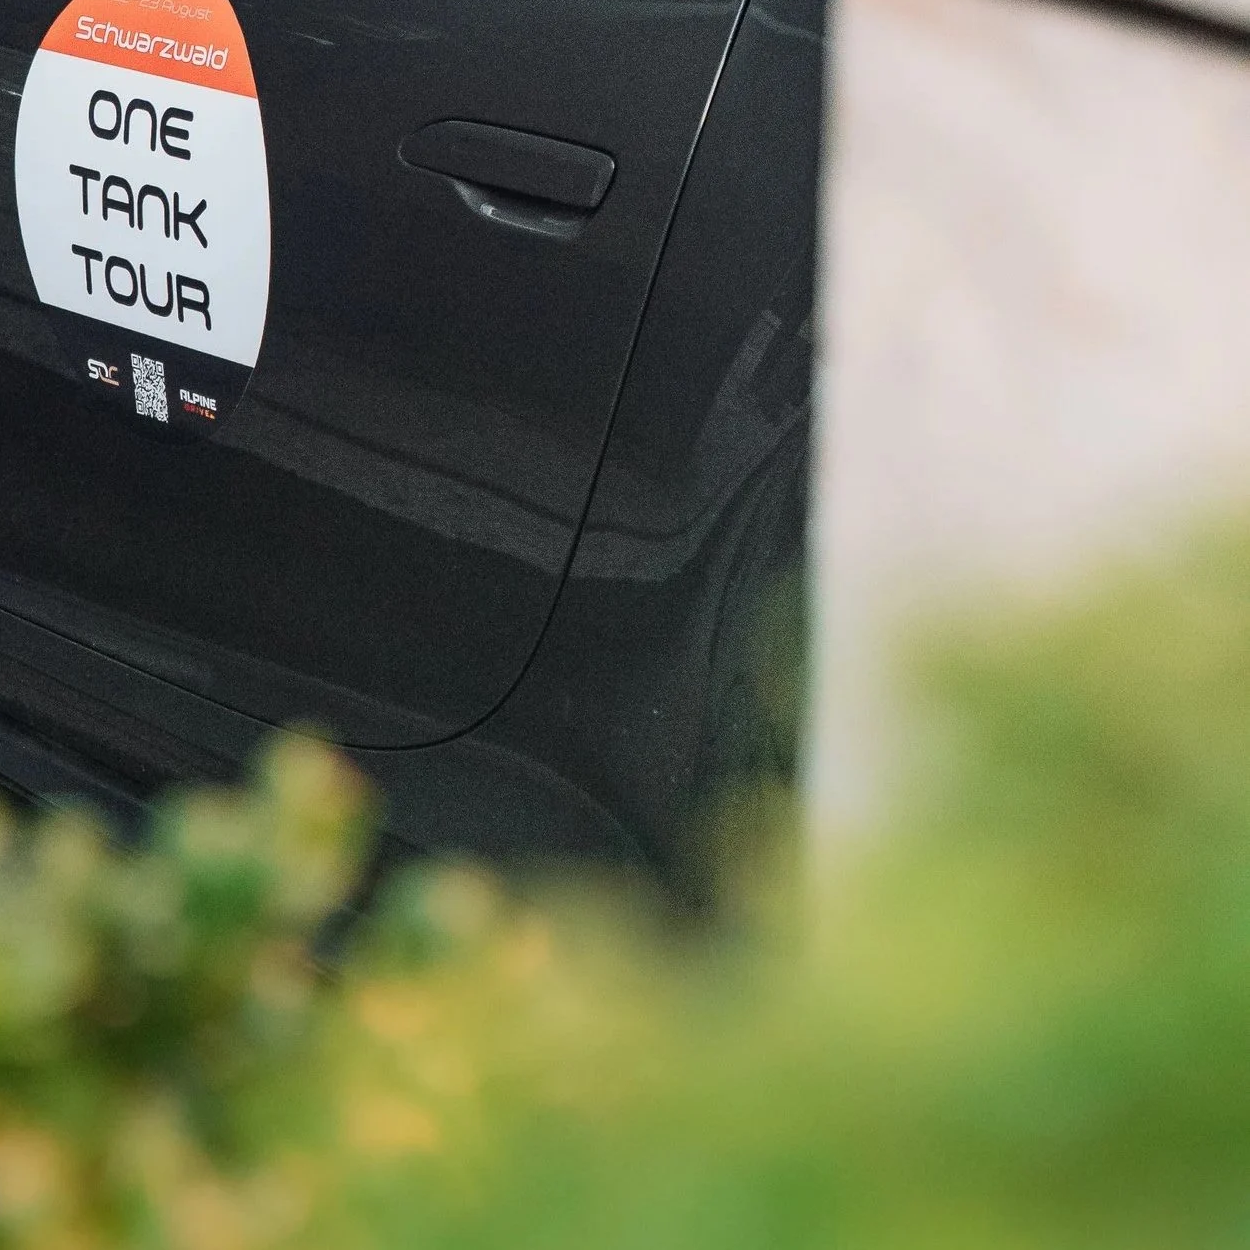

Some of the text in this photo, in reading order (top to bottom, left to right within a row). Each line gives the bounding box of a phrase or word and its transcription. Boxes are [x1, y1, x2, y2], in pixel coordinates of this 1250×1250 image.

[74, 15, 229, 70] Schwarzwald
[88, 89, 194, 161] ONE
[69, 163, 208, 249] TANK
[71, 243, 212, 331] TOUR
[179, 388, 217, 412] ALPINE
